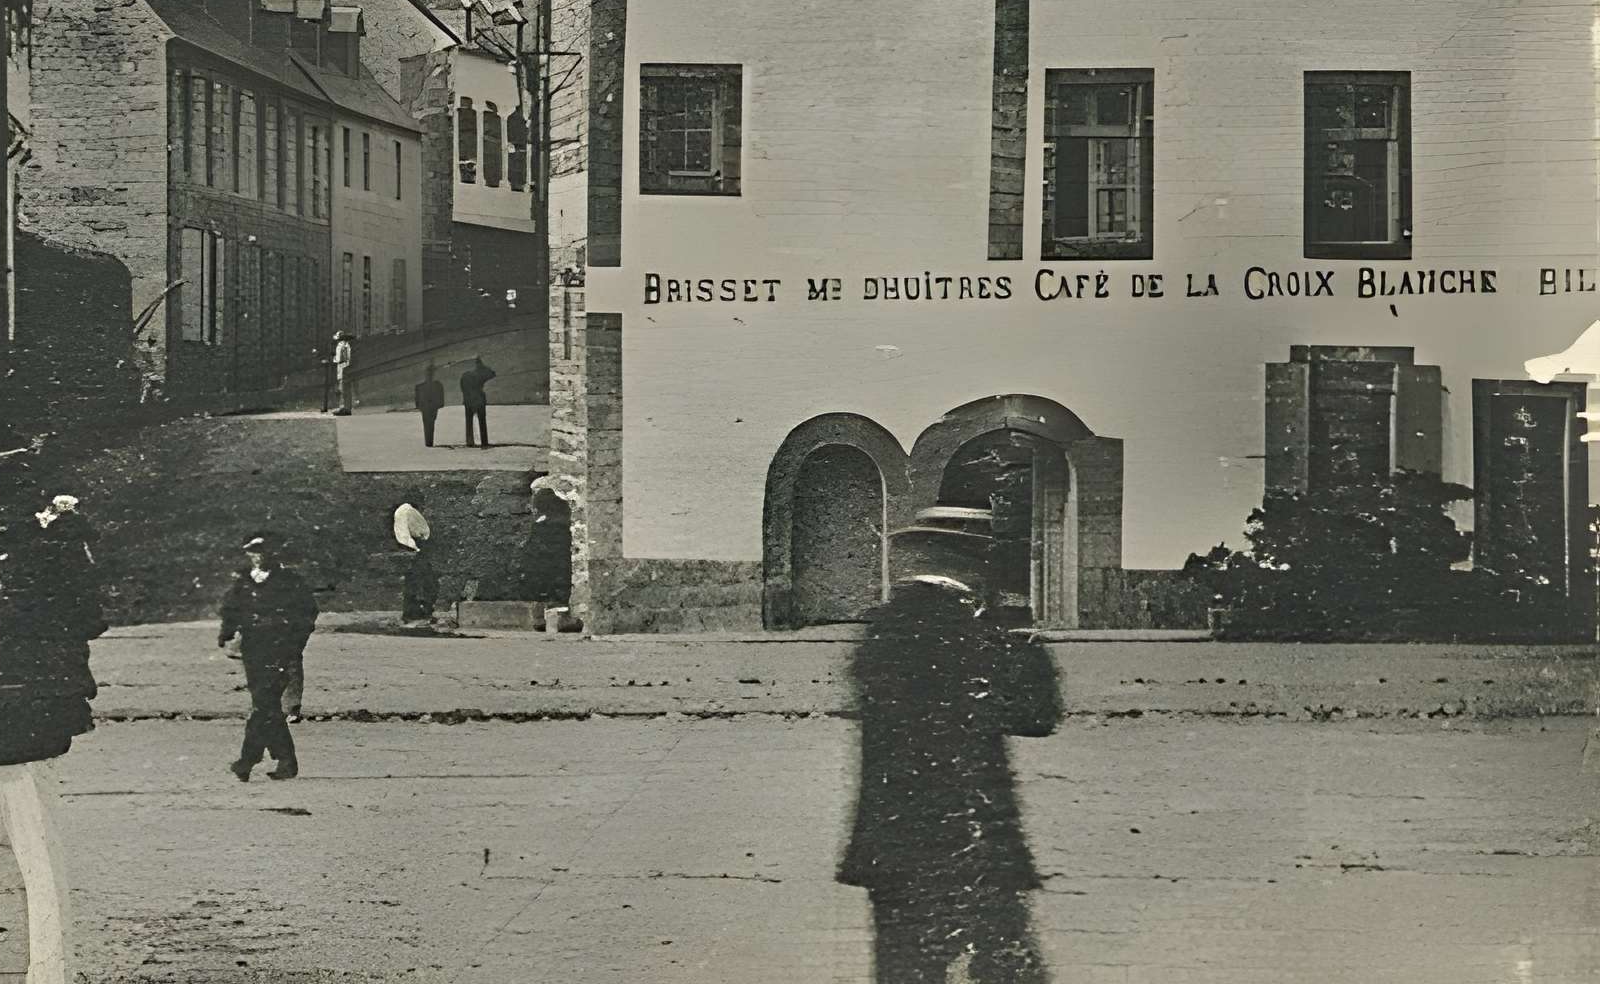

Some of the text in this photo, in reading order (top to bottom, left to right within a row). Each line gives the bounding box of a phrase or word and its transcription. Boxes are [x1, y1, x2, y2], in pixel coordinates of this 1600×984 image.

[1034, 268, 1111, 302] CAFÉ
[1131, 273, 1165, 299] DE
[1186, 272, 1220, 298] LA
[1243, 266, 1336, 301] CROIX
[1357, 266, 1498, 300] BLANCHE
